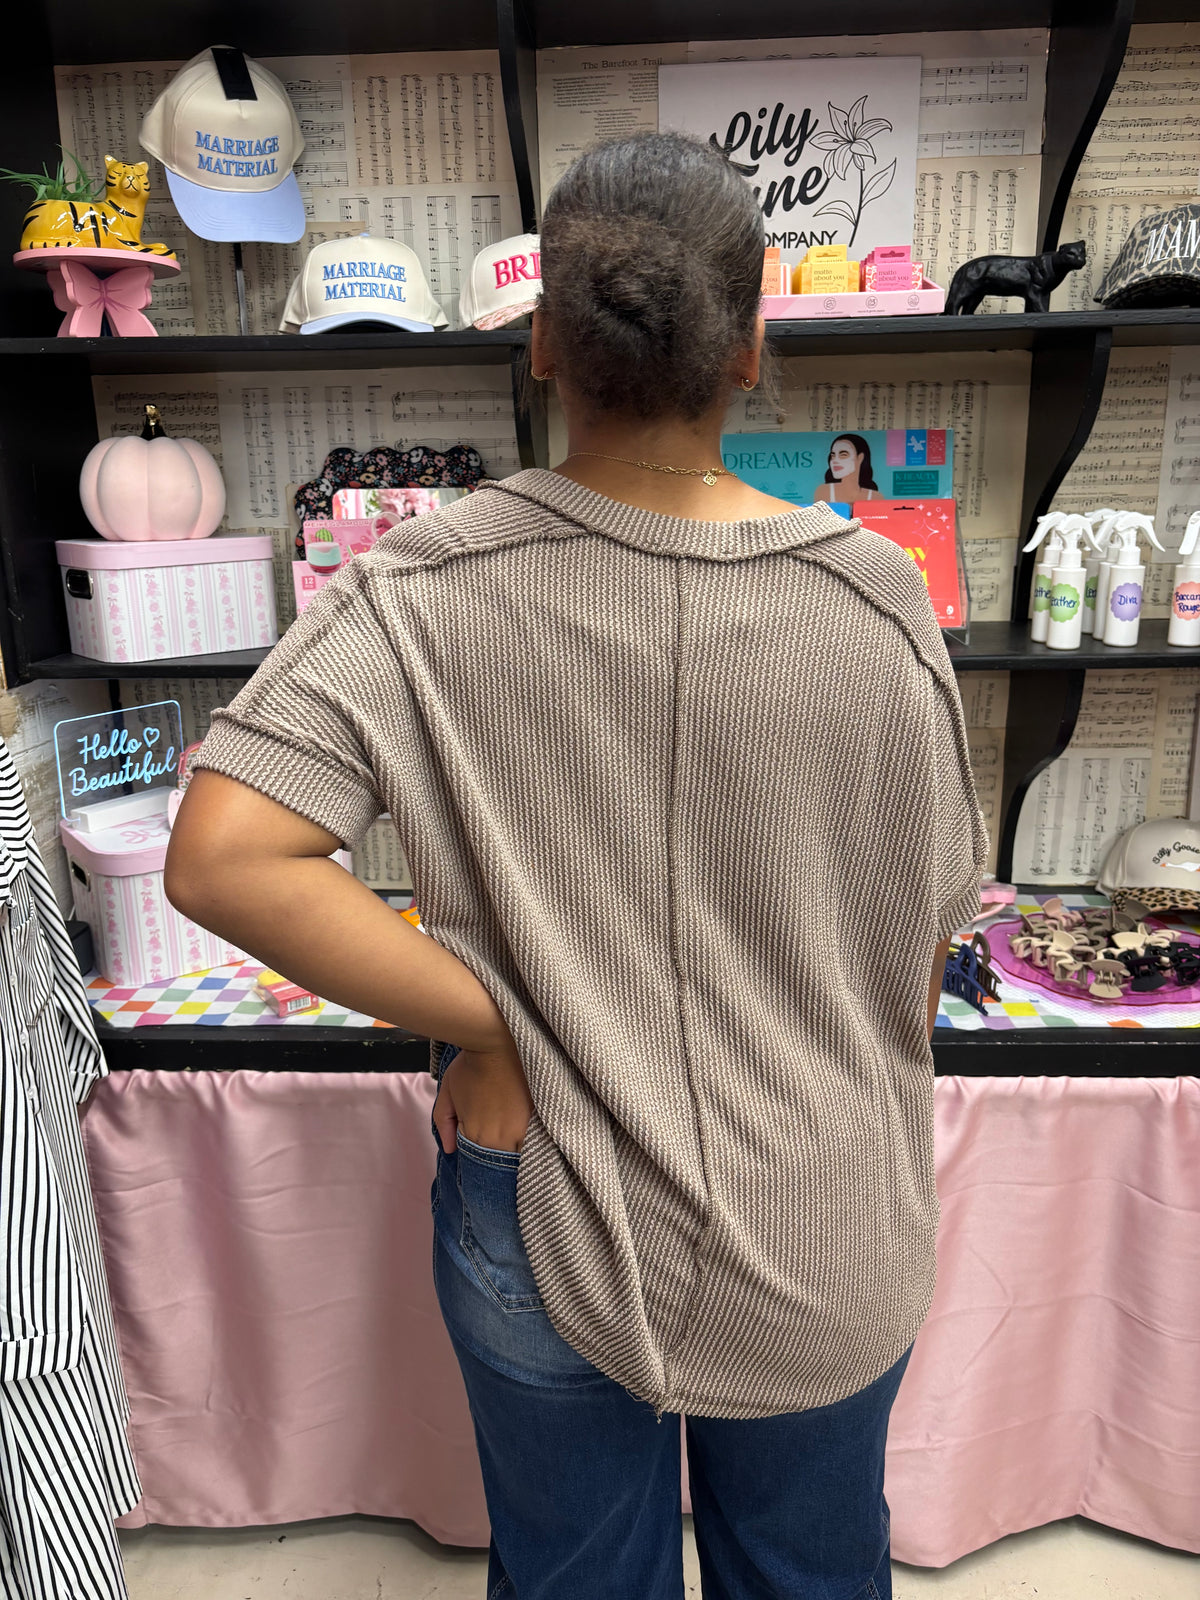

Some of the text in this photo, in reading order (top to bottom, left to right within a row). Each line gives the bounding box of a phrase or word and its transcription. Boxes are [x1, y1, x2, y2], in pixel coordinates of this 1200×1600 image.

[194, 130, 280, 157] MARRIAGE
[197, 153, 278, 178] MATERIAL
[322, 261, 407, 282] MARRIAGE
[324, 281, 406, 303] MATERIAL
[723, 450, 814, 470] DREAMS
[304, 577, 314, 585] 12
[1118, 594, 1138, 605] Diva
[77, 729, 142, 765] Hello
[68, 746, 177, 796] Beautiful
[1172, 841, 1200, 854] Goose
